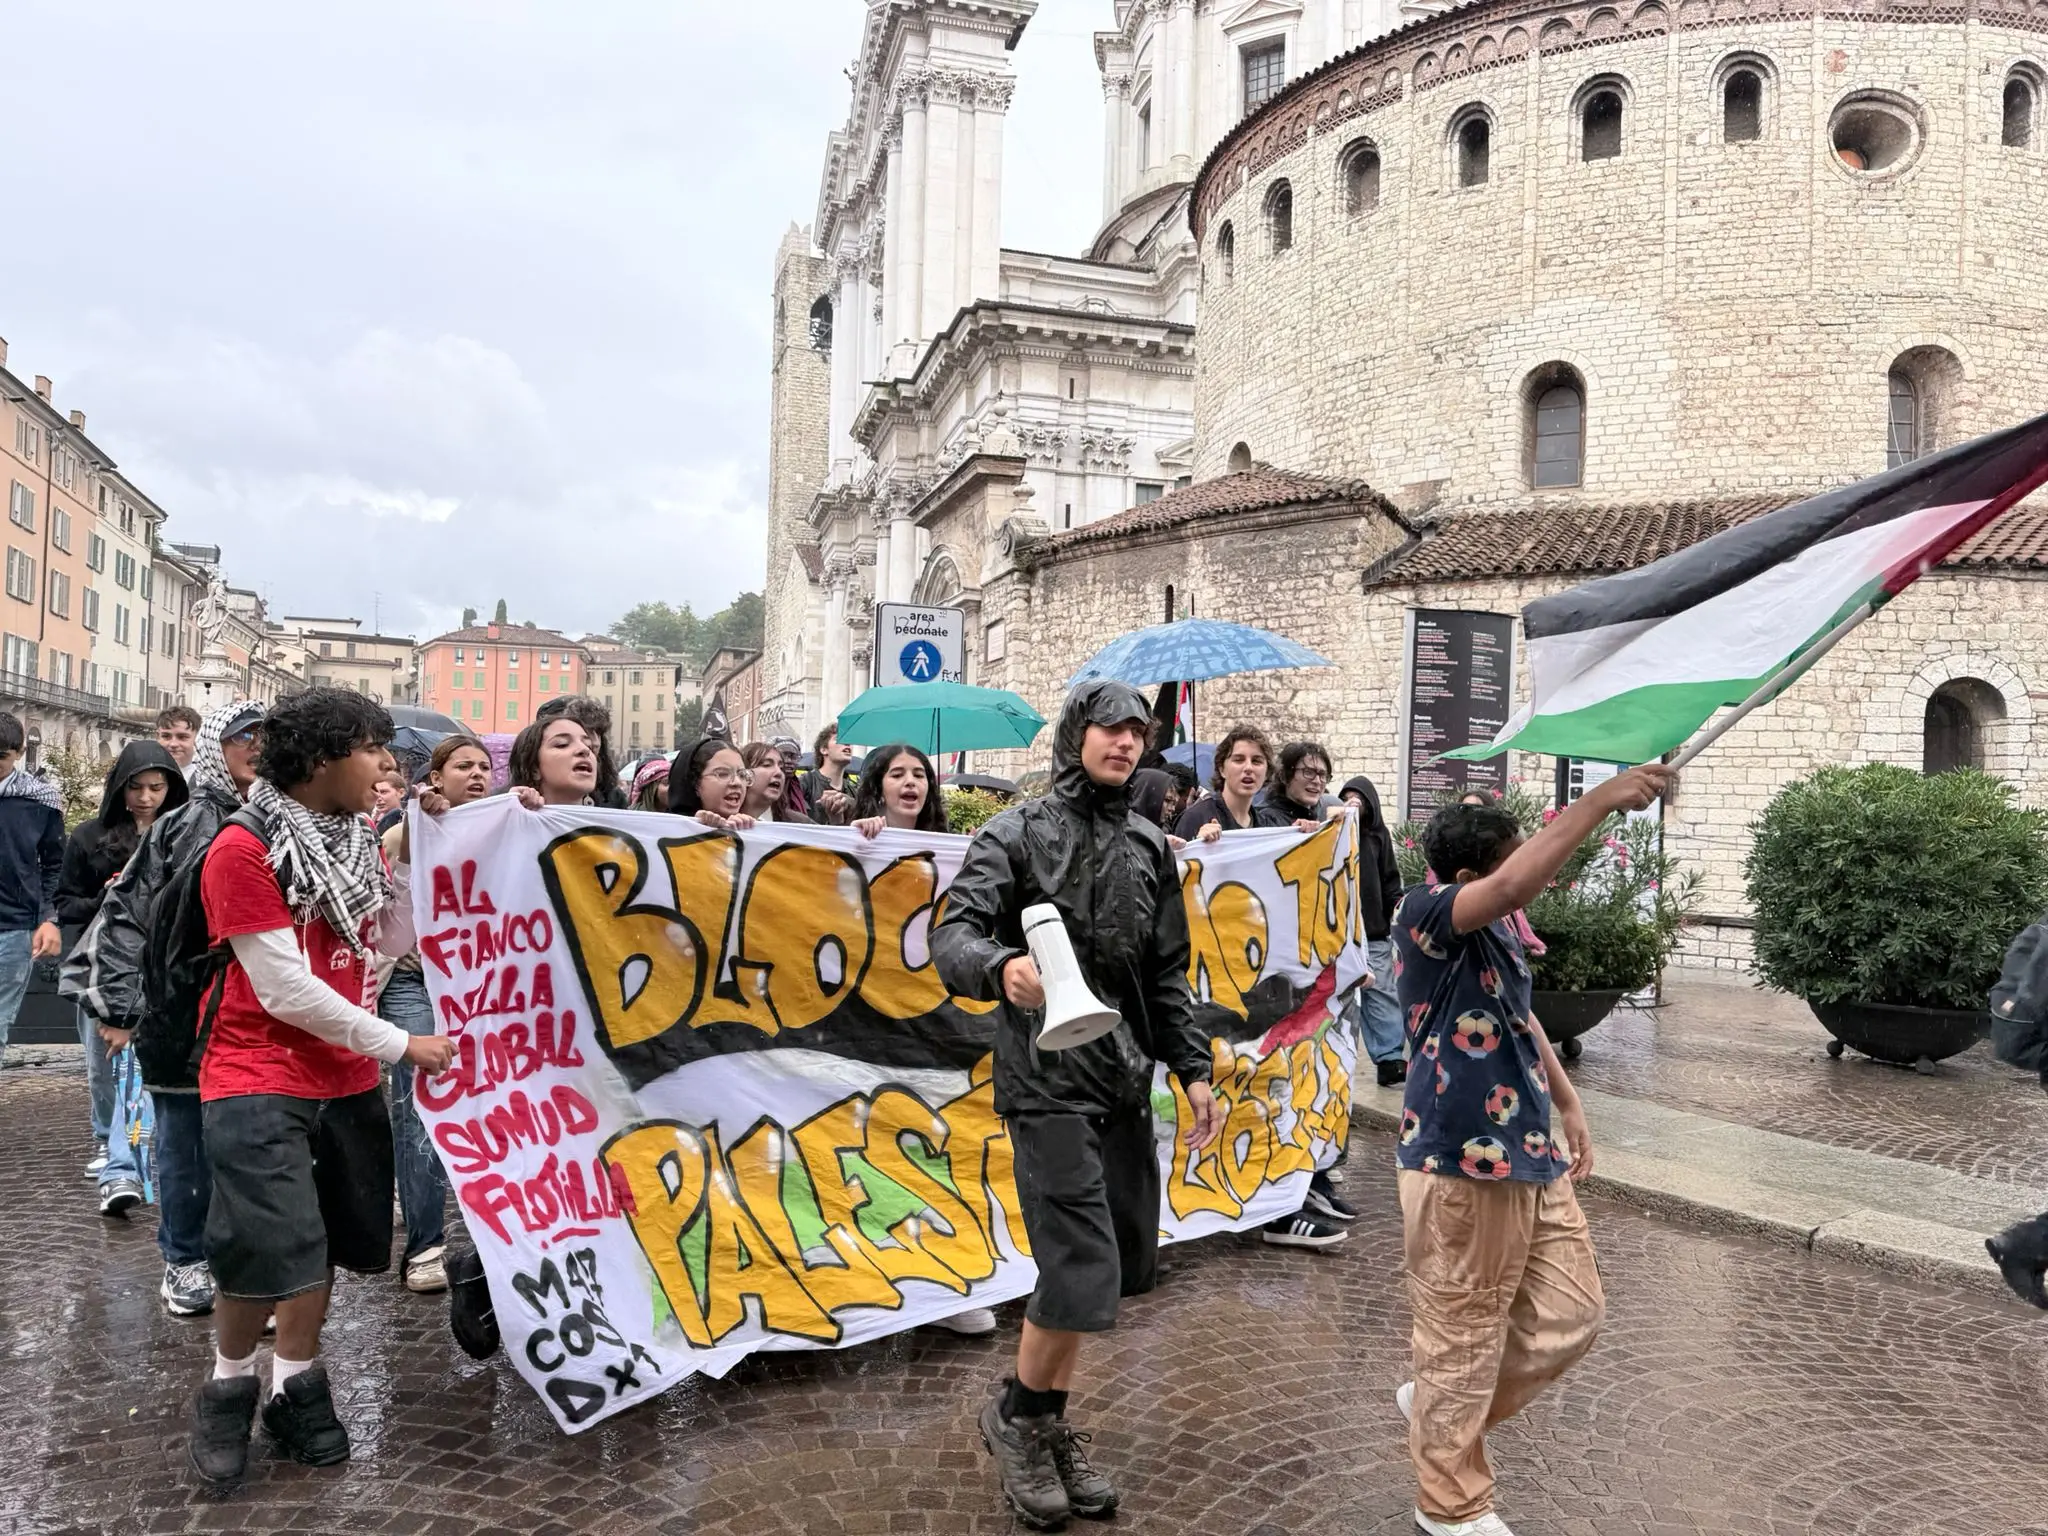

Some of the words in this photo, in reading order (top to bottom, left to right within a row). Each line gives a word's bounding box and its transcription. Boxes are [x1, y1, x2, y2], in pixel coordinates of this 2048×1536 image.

[895, 625, 949, 637] pedonale
[909, 612, 935, 622] area
[432, 859, 497, 922] AL
[416, 1009, 585, 1113] GLOBAL
[434, 1084, 599, 1173] SUMUD
